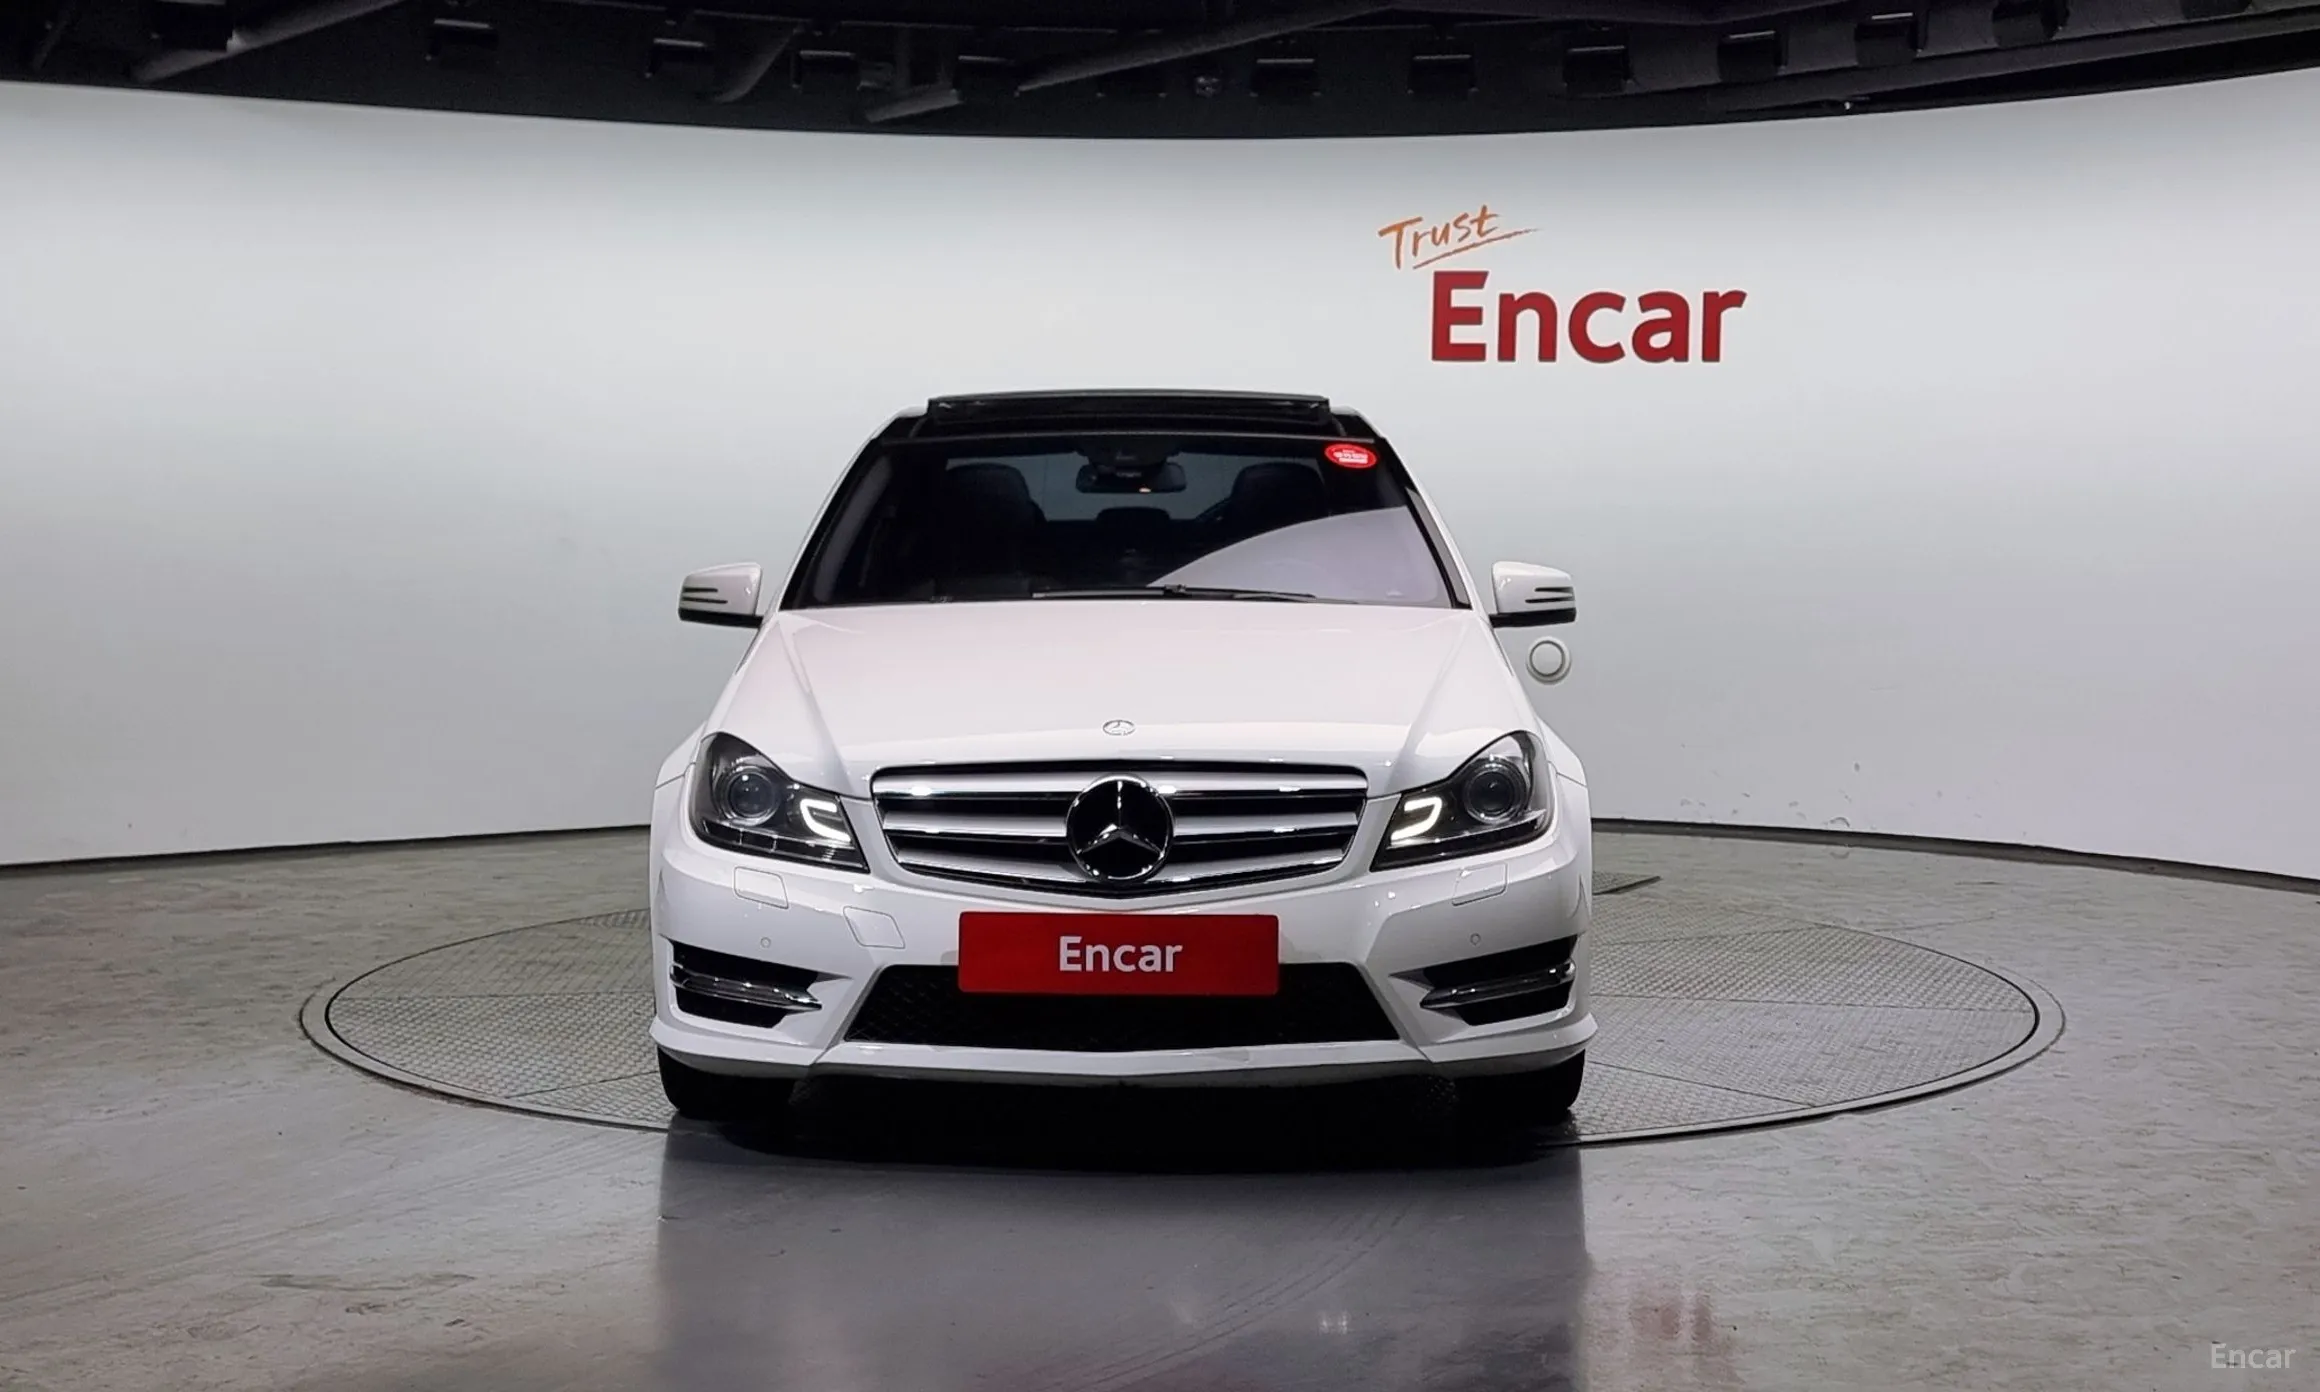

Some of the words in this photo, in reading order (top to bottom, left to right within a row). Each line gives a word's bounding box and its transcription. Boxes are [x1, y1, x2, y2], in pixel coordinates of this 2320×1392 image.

[1378, 204, 1500, 270] Trust
[1432, 270, 1747, 363] Encar
[1059, 935, 1183, 973] Encar
